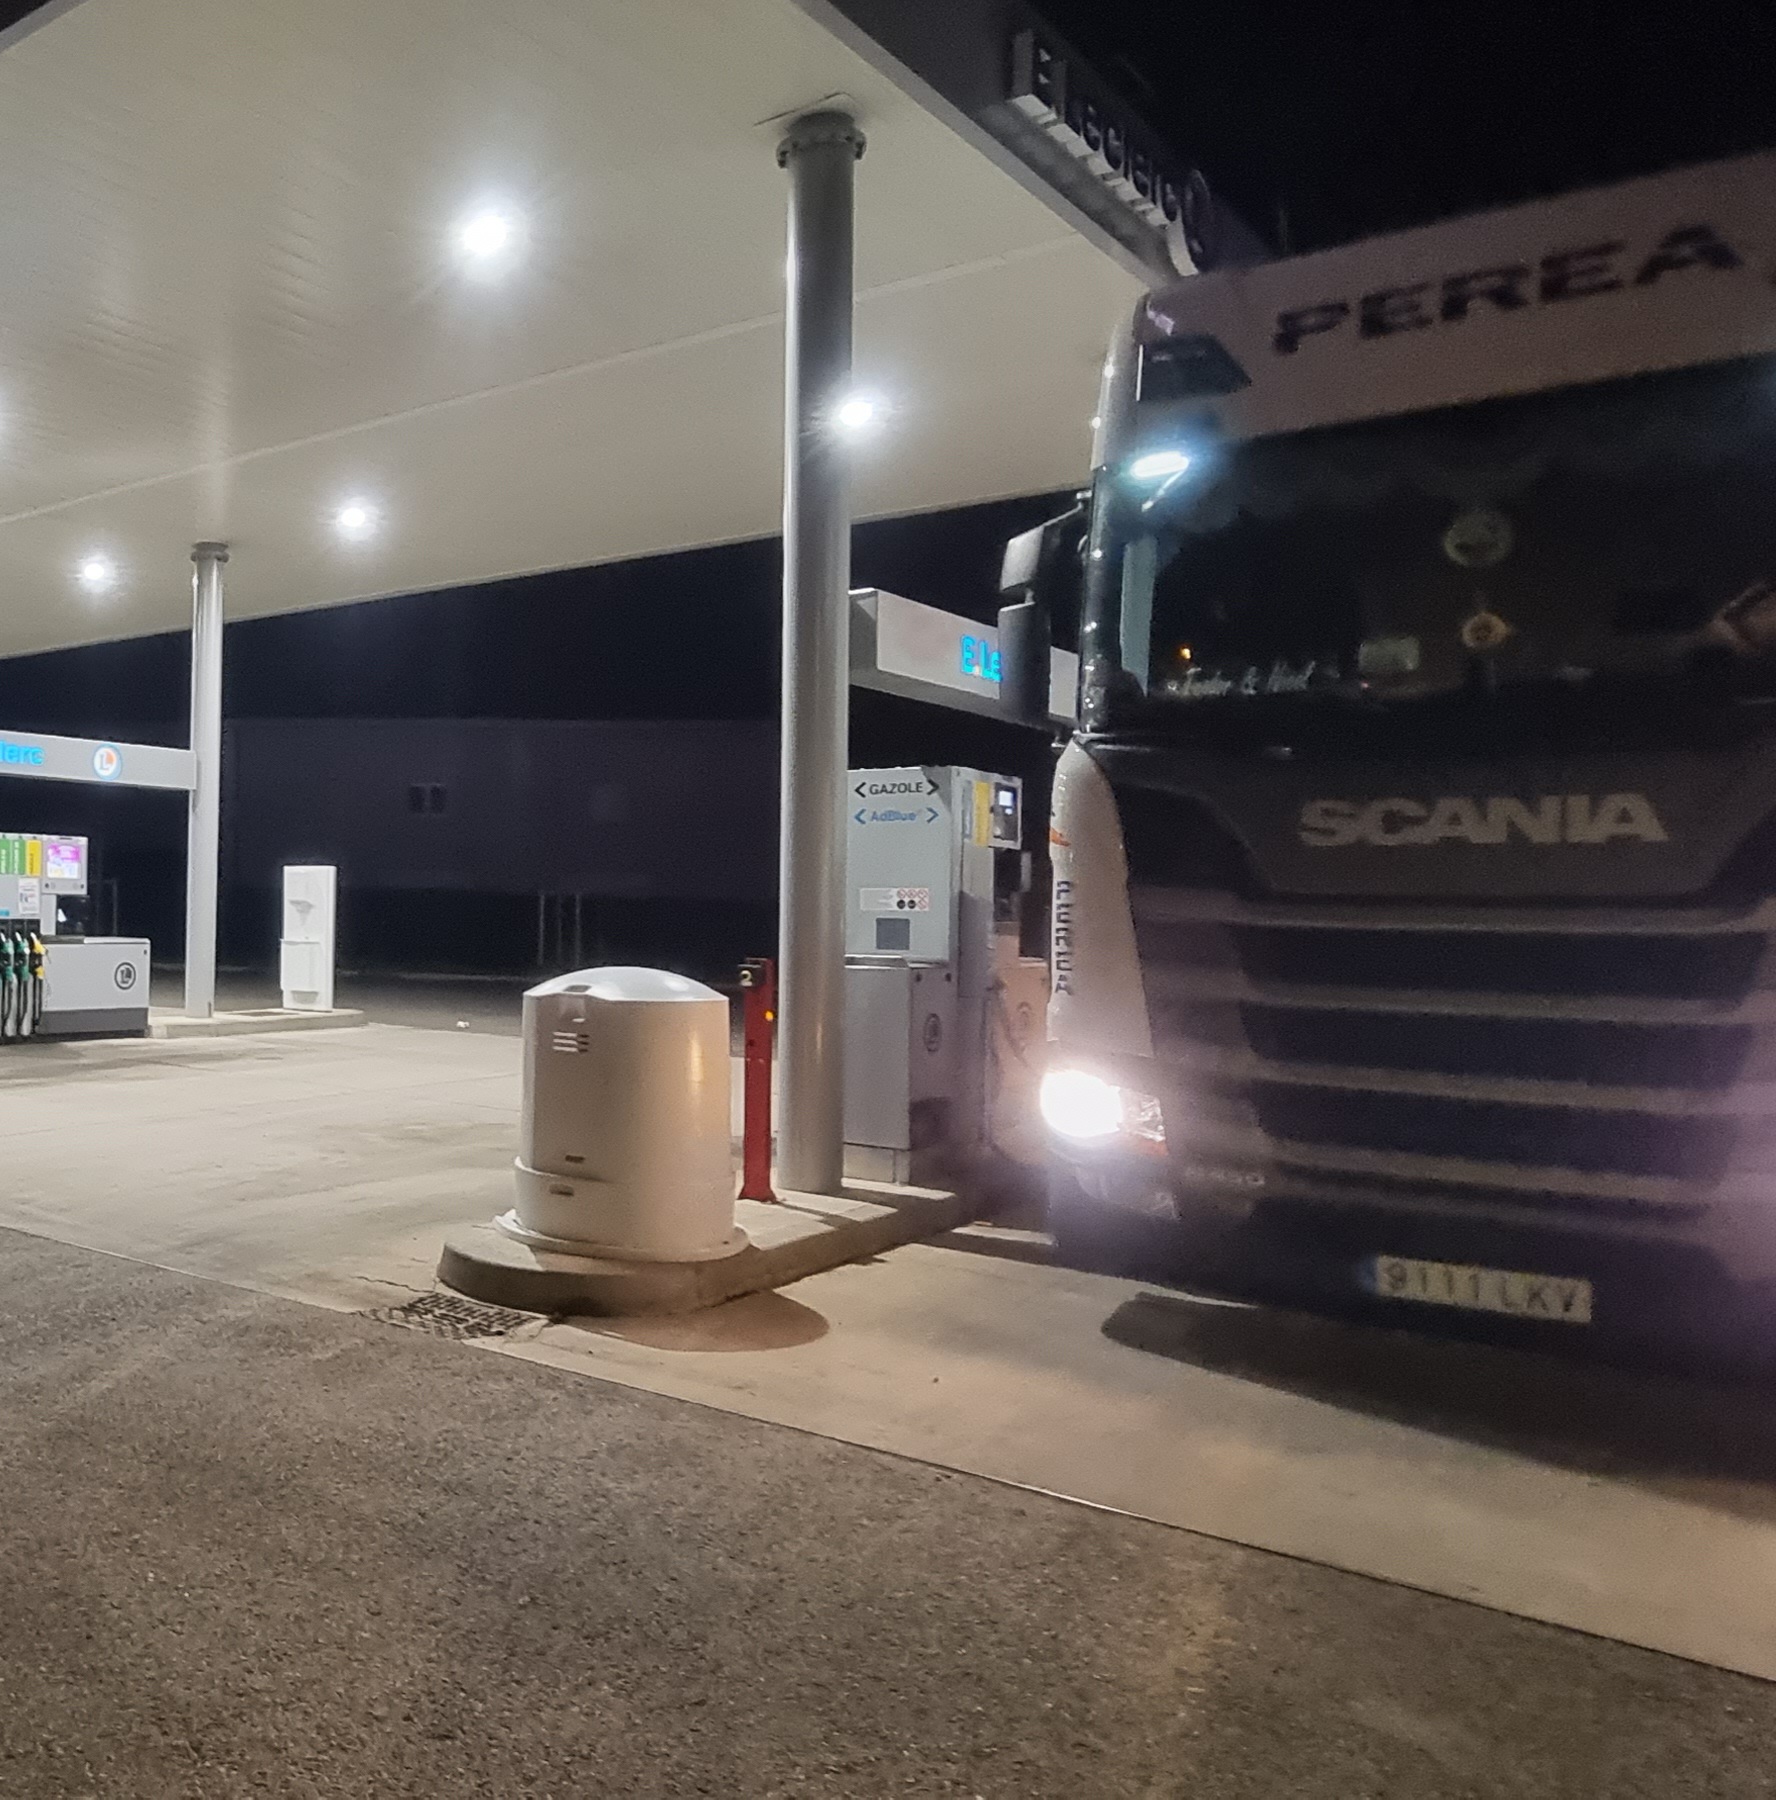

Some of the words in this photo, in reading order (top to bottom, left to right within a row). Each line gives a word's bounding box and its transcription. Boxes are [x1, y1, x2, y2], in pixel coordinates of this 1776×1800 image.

[1271, 223, 1745, 356] PEREA
[869, 782, 923, 795] GAZOLE
[1298, 793, 1670, 848] SCANIA
[739, 969, 754, 987] 2
